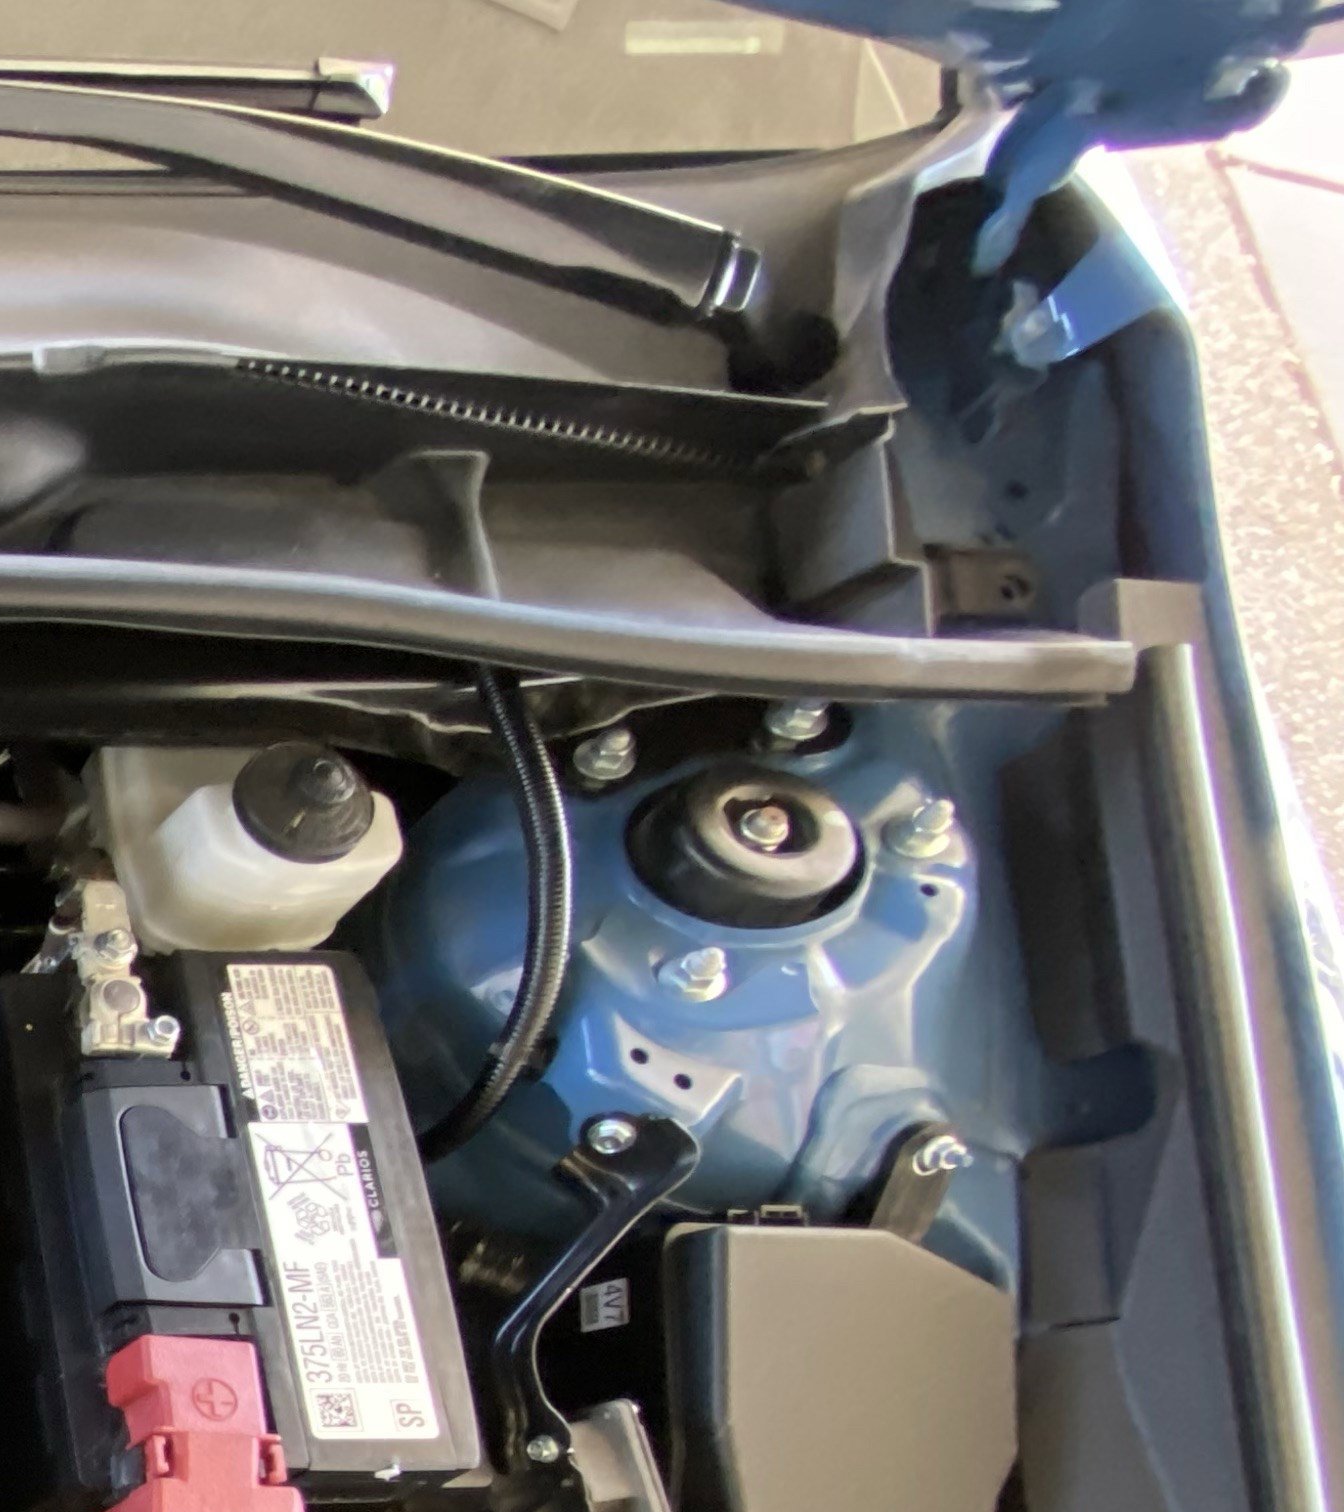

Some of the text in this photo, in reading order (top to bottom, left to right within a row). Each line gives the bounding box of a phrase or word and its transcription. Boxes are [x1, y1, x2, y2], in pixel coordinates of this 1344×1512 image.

[335, 1153, 354, 1176] Pb
[358, 1150, 380, 1208] CLARIOS
[283, 1261, 332, 1383] 375LN2-MF
[396, 1403, 425, 1427] SP
